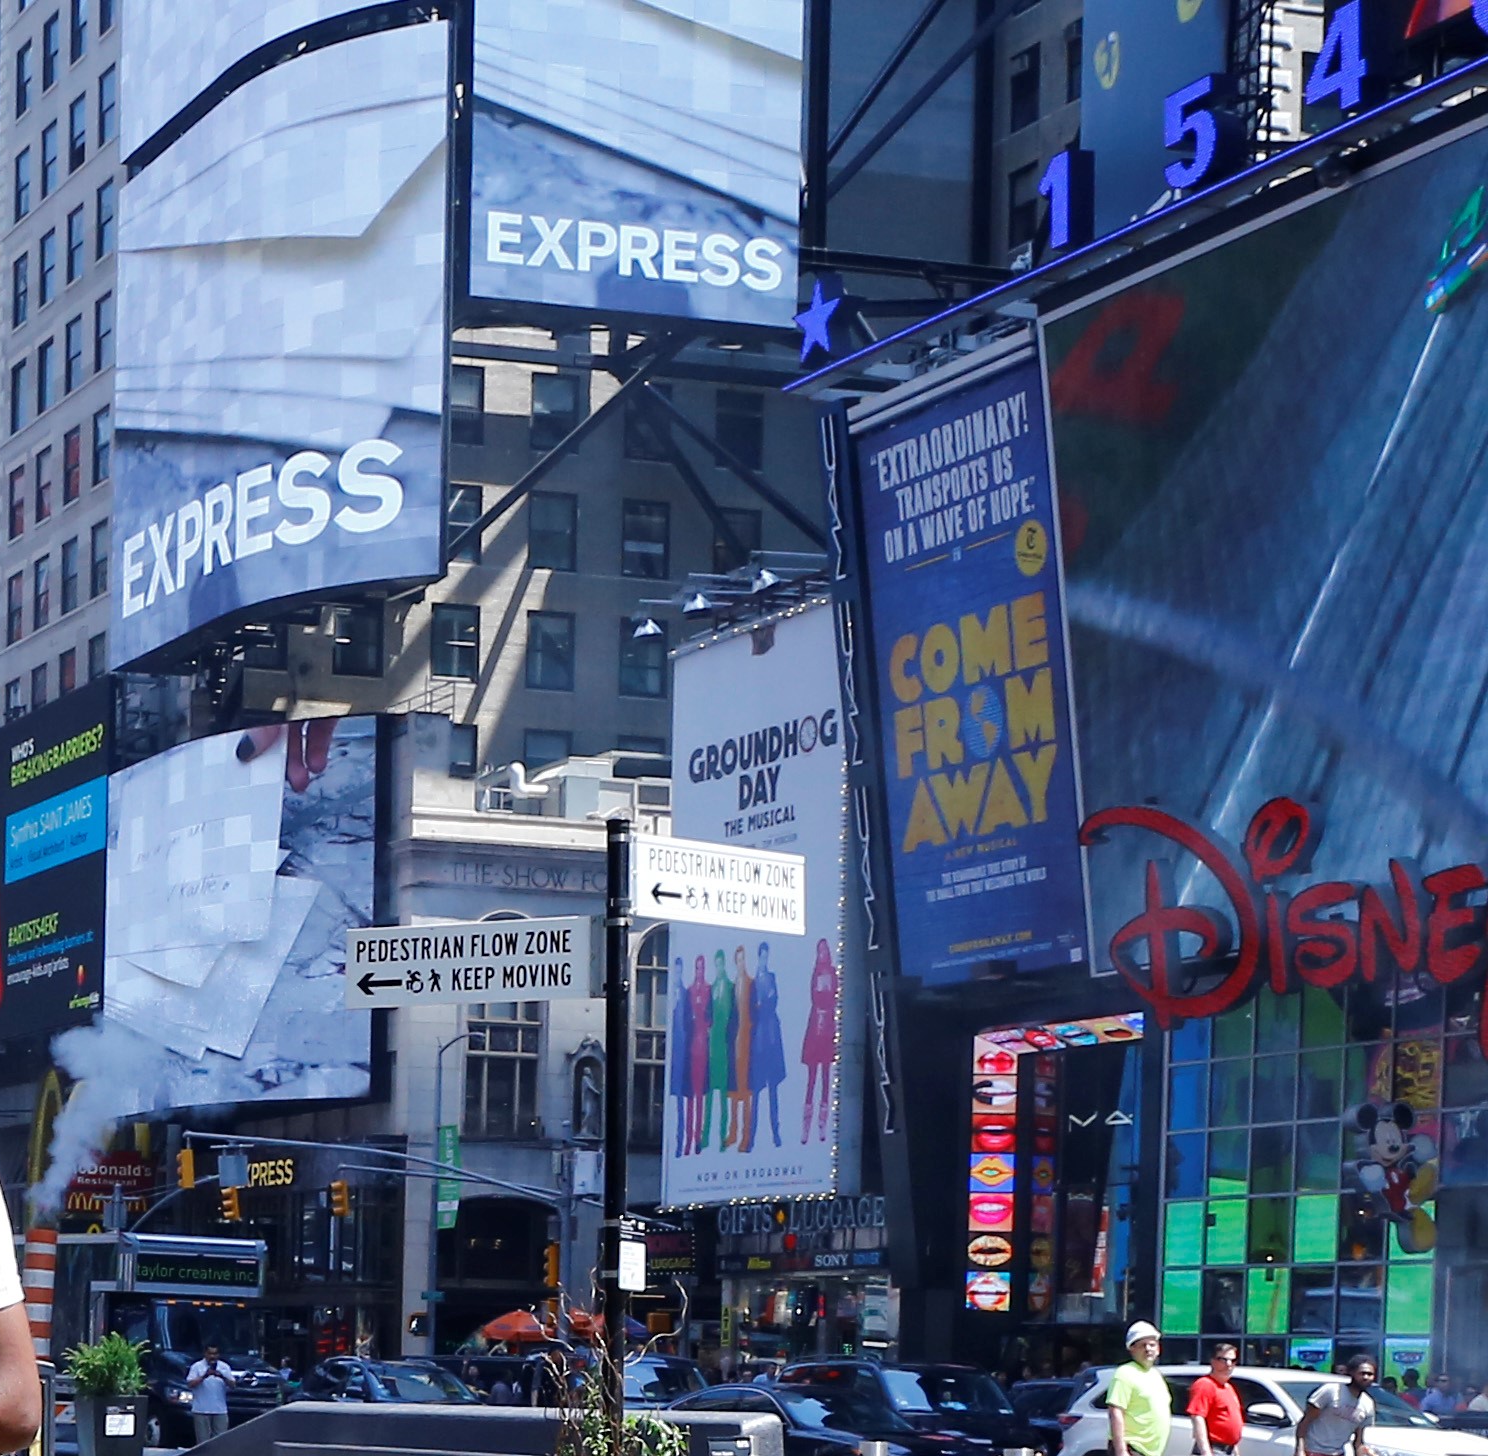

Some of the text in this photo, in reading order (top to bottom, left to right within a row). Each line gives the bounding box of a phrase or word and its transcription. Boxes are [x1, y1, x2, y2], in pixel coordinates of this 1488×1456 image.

[487, 211, 783, 292] EXPRESS
[895, 445, 1013, 522] TRANSPORTS US
[121, 438, 405, 619] EXPRESS
[884, 525, 904, 563] ON
[907, 521, 918, 556] A
[920, 504, 964, 550] WAVE
[967, 496, 986, 532] OF
[889, 590, 1050, 704] COME
[688, 709, 838, 784] GROUNDHOG
[737, 764, 782, 812] DAY
[901, 744, 1058, 854] AWAY
[723, 804, 796, 838] THE MUSICAL
[581, 870, 607, 892] FO
[648, 848, 797, 890] PEDESTRIAN FLOW ZONE
[716, 887, 797, 923] KEEP MOVING
[355, 929, 572, 965] PEDESTRIAN FLOW ZONE
[451, 962, 572, 992] KEEP MOVING
[74, 1164, 153, 1177] cDonald's
[244, 1158, 294, 1188] XPRESS
[697, 1166, 804, 1182] NOW ON BROADWAY
[717, 1196, 886, 1235] GIFTS LUGGAGE
[138, 1263, 175, 1281] taylor
[178, 1266, 230, 1281] creative
[814, 1254, 849, 1267] SONY
